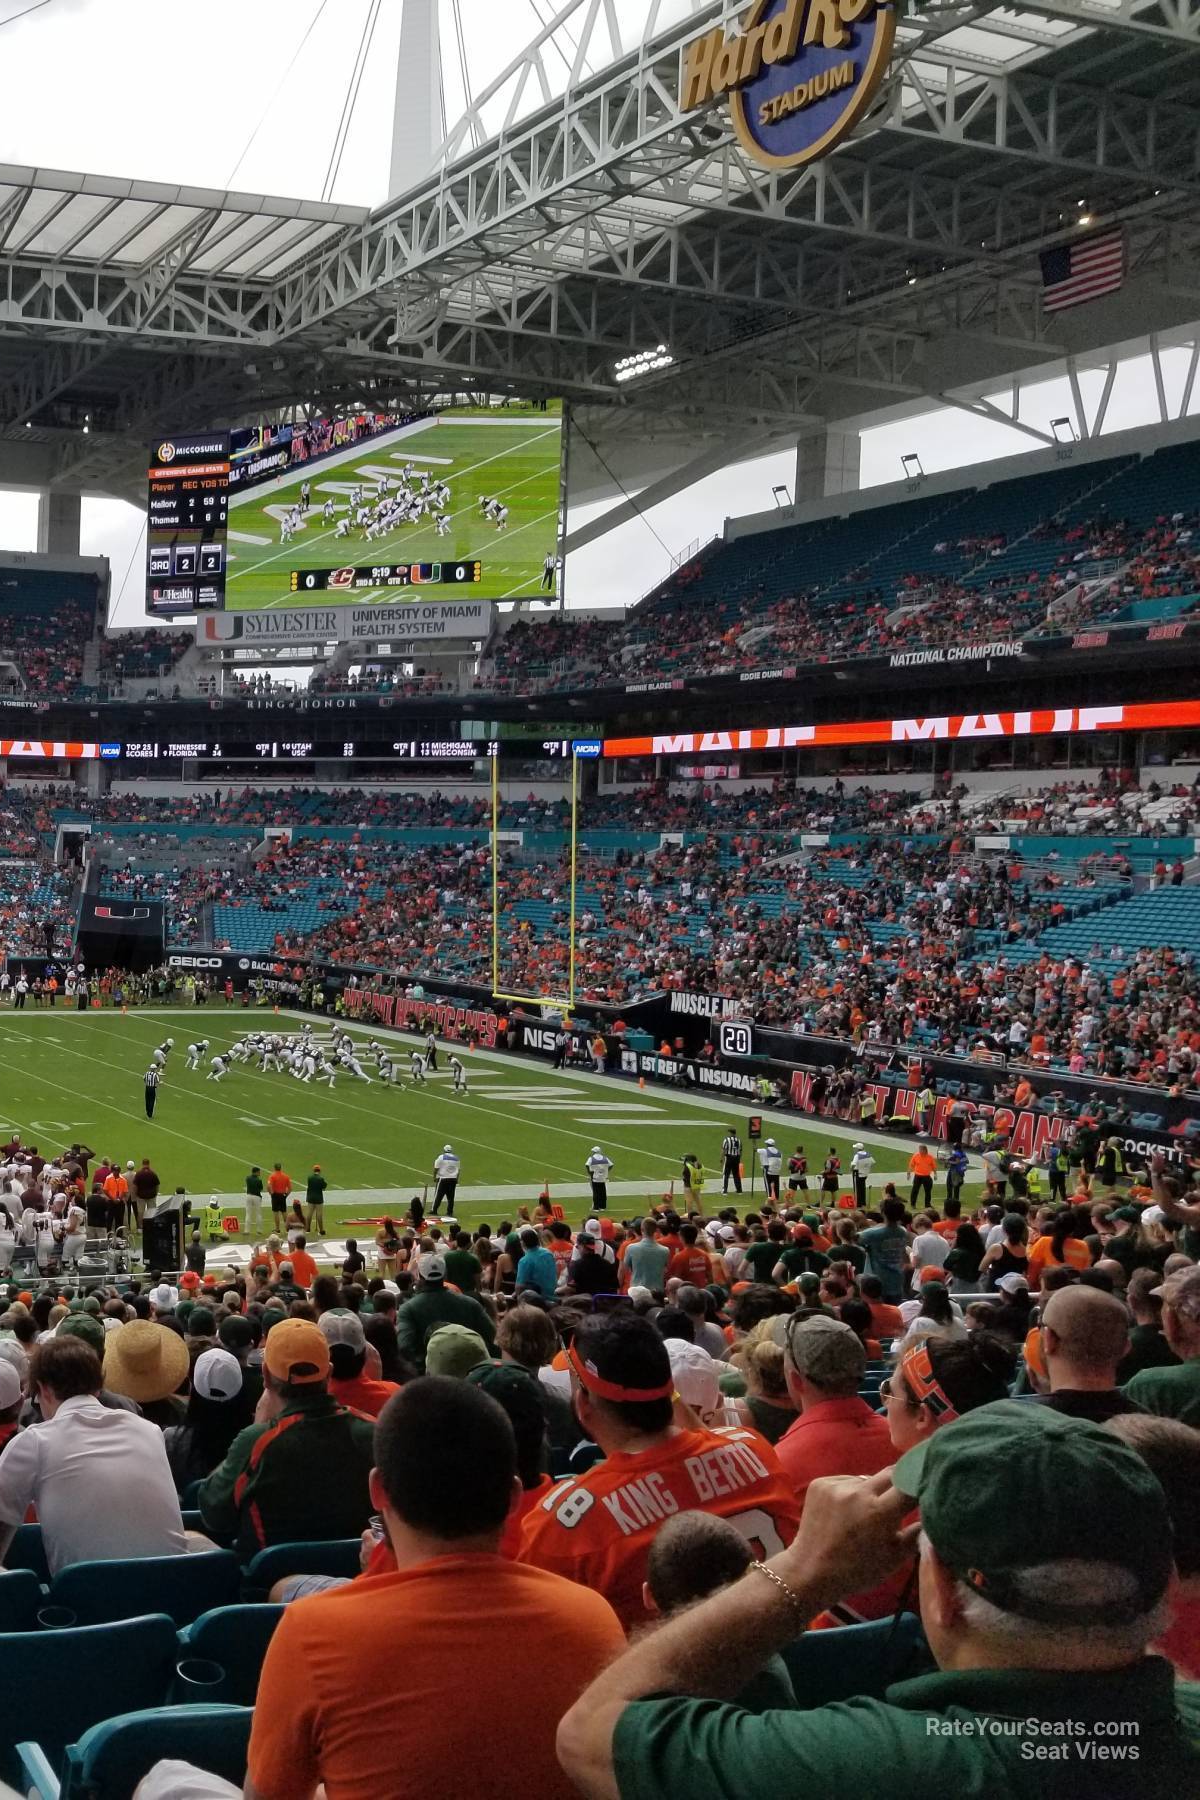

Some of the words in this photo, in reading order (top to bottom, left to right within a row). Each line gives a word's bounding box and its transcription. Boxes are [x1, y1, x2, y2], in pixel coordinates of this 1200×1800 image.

[680, 0, 803, 113] Hard
[758, 60, 855, 125] STADIUM
[176, 444, 223, 455] MICCOSUKEE
[201, 480, 217, 488] YDS
[219, 479, 229, 487] TD
[189, 498, 195, 506] 2
[189, 514, 193, 522] 1
[220, 512, 225, 520] 0
[151, 560, 169, 570] 3RD
[182, 559, 189, 569] 2
[207, 557, 215, 567] 2
[371, 567, 390, 578] 9:19
[456, 567, 465, 580] 0
[305, 575, 315, 588] 0
[352, 608, 419, 622] UNIVERSITY
[423, 607, 439, 619] OF
[441, 605, 482, 618] MIAMI
[246, 612, 337, 634] SYLVESTER
[352, 623, 396, 636] HEALTH
[398, 621, 445, 635] SYSTEM
[889, 650, 945, 667] NATIONAL
[947, 641, 1024, 661] CHAMPIONS
[740, 672, 761, 681] EDDIE
[648, 682, 672, 691] BLADES
[247, 700, 285, 709] RING
[300, 699, 356, 709] HONOR
[393, 742, 408, 750] QTR
[169, 955, 222, 968] GEICO
[671, 991, 719, 1017] MUSCLE
[725, 1028, 747, 1053] 20
[751, 1118, 761, 1132] 3
[227, 1217, 239, 1231] 20
[601, 1472, 680, 1536] KING
[684, 1442, 770, 1502] BERTO
[542, 1480, 594, 1528] 18
